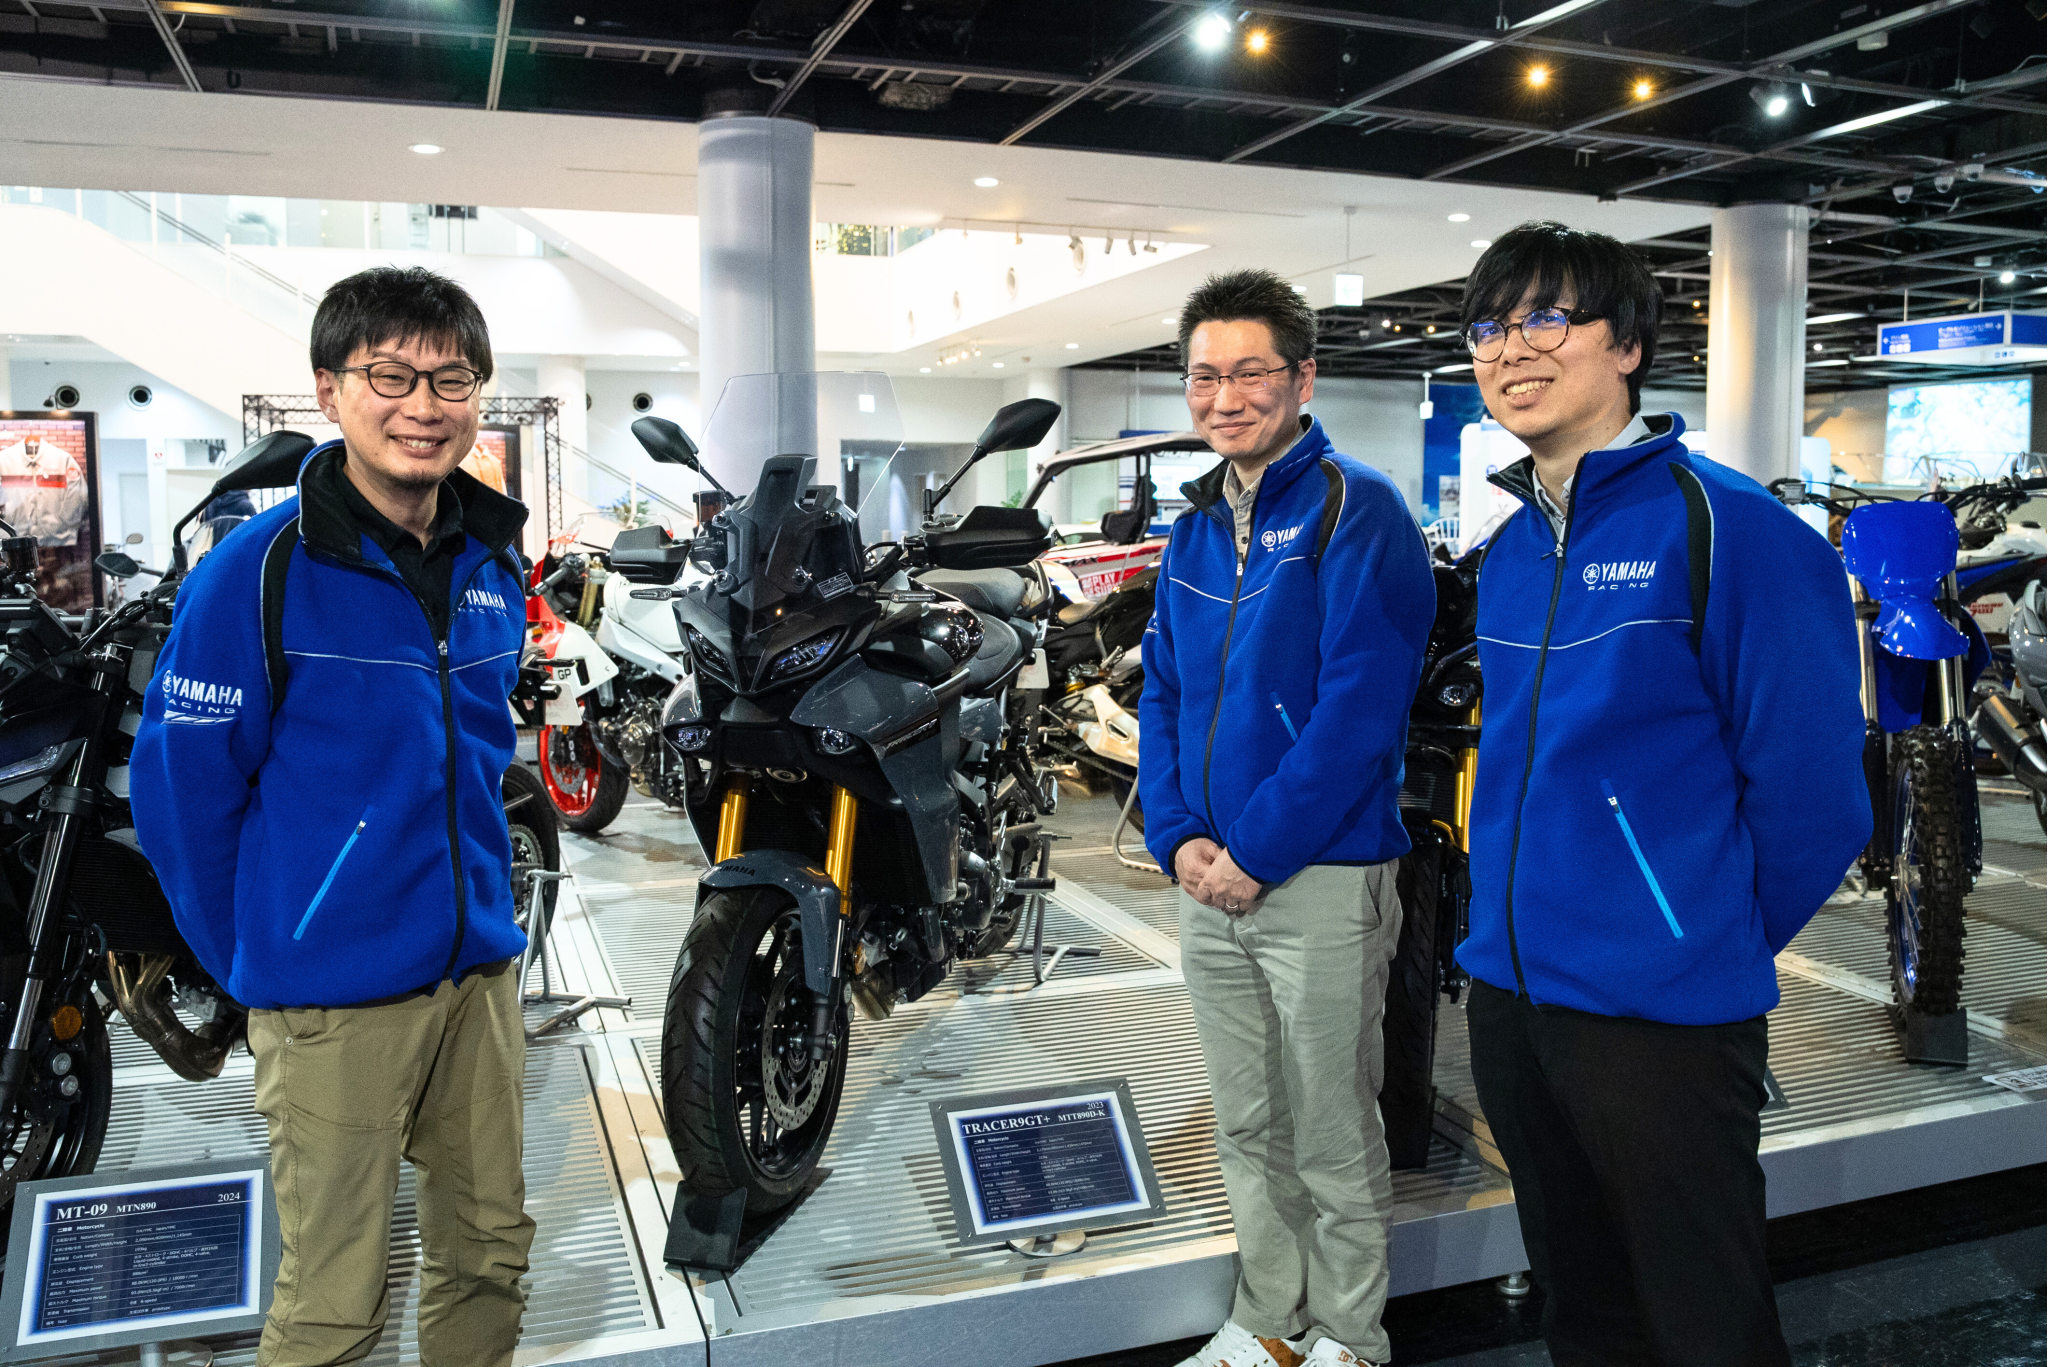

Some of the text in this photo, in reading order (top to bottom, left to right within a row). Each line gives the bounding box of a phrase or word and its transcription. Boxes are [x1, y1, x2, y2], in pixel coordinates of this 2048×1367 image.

[1602, 561, 1656, 581] YAMAHA
[465, 589, 507, 610] YAMAHA
[558, 668, 571, 680] GP
[173, 675, 242, 707] YAMAHA
[1087, 1101, 1104, 1110] 2023
[962, 1110, 1106, 1134] TRACER9GT+ MTT890D-K
[56, 1192, 240, 1220] MT-09 MTN890 2024
